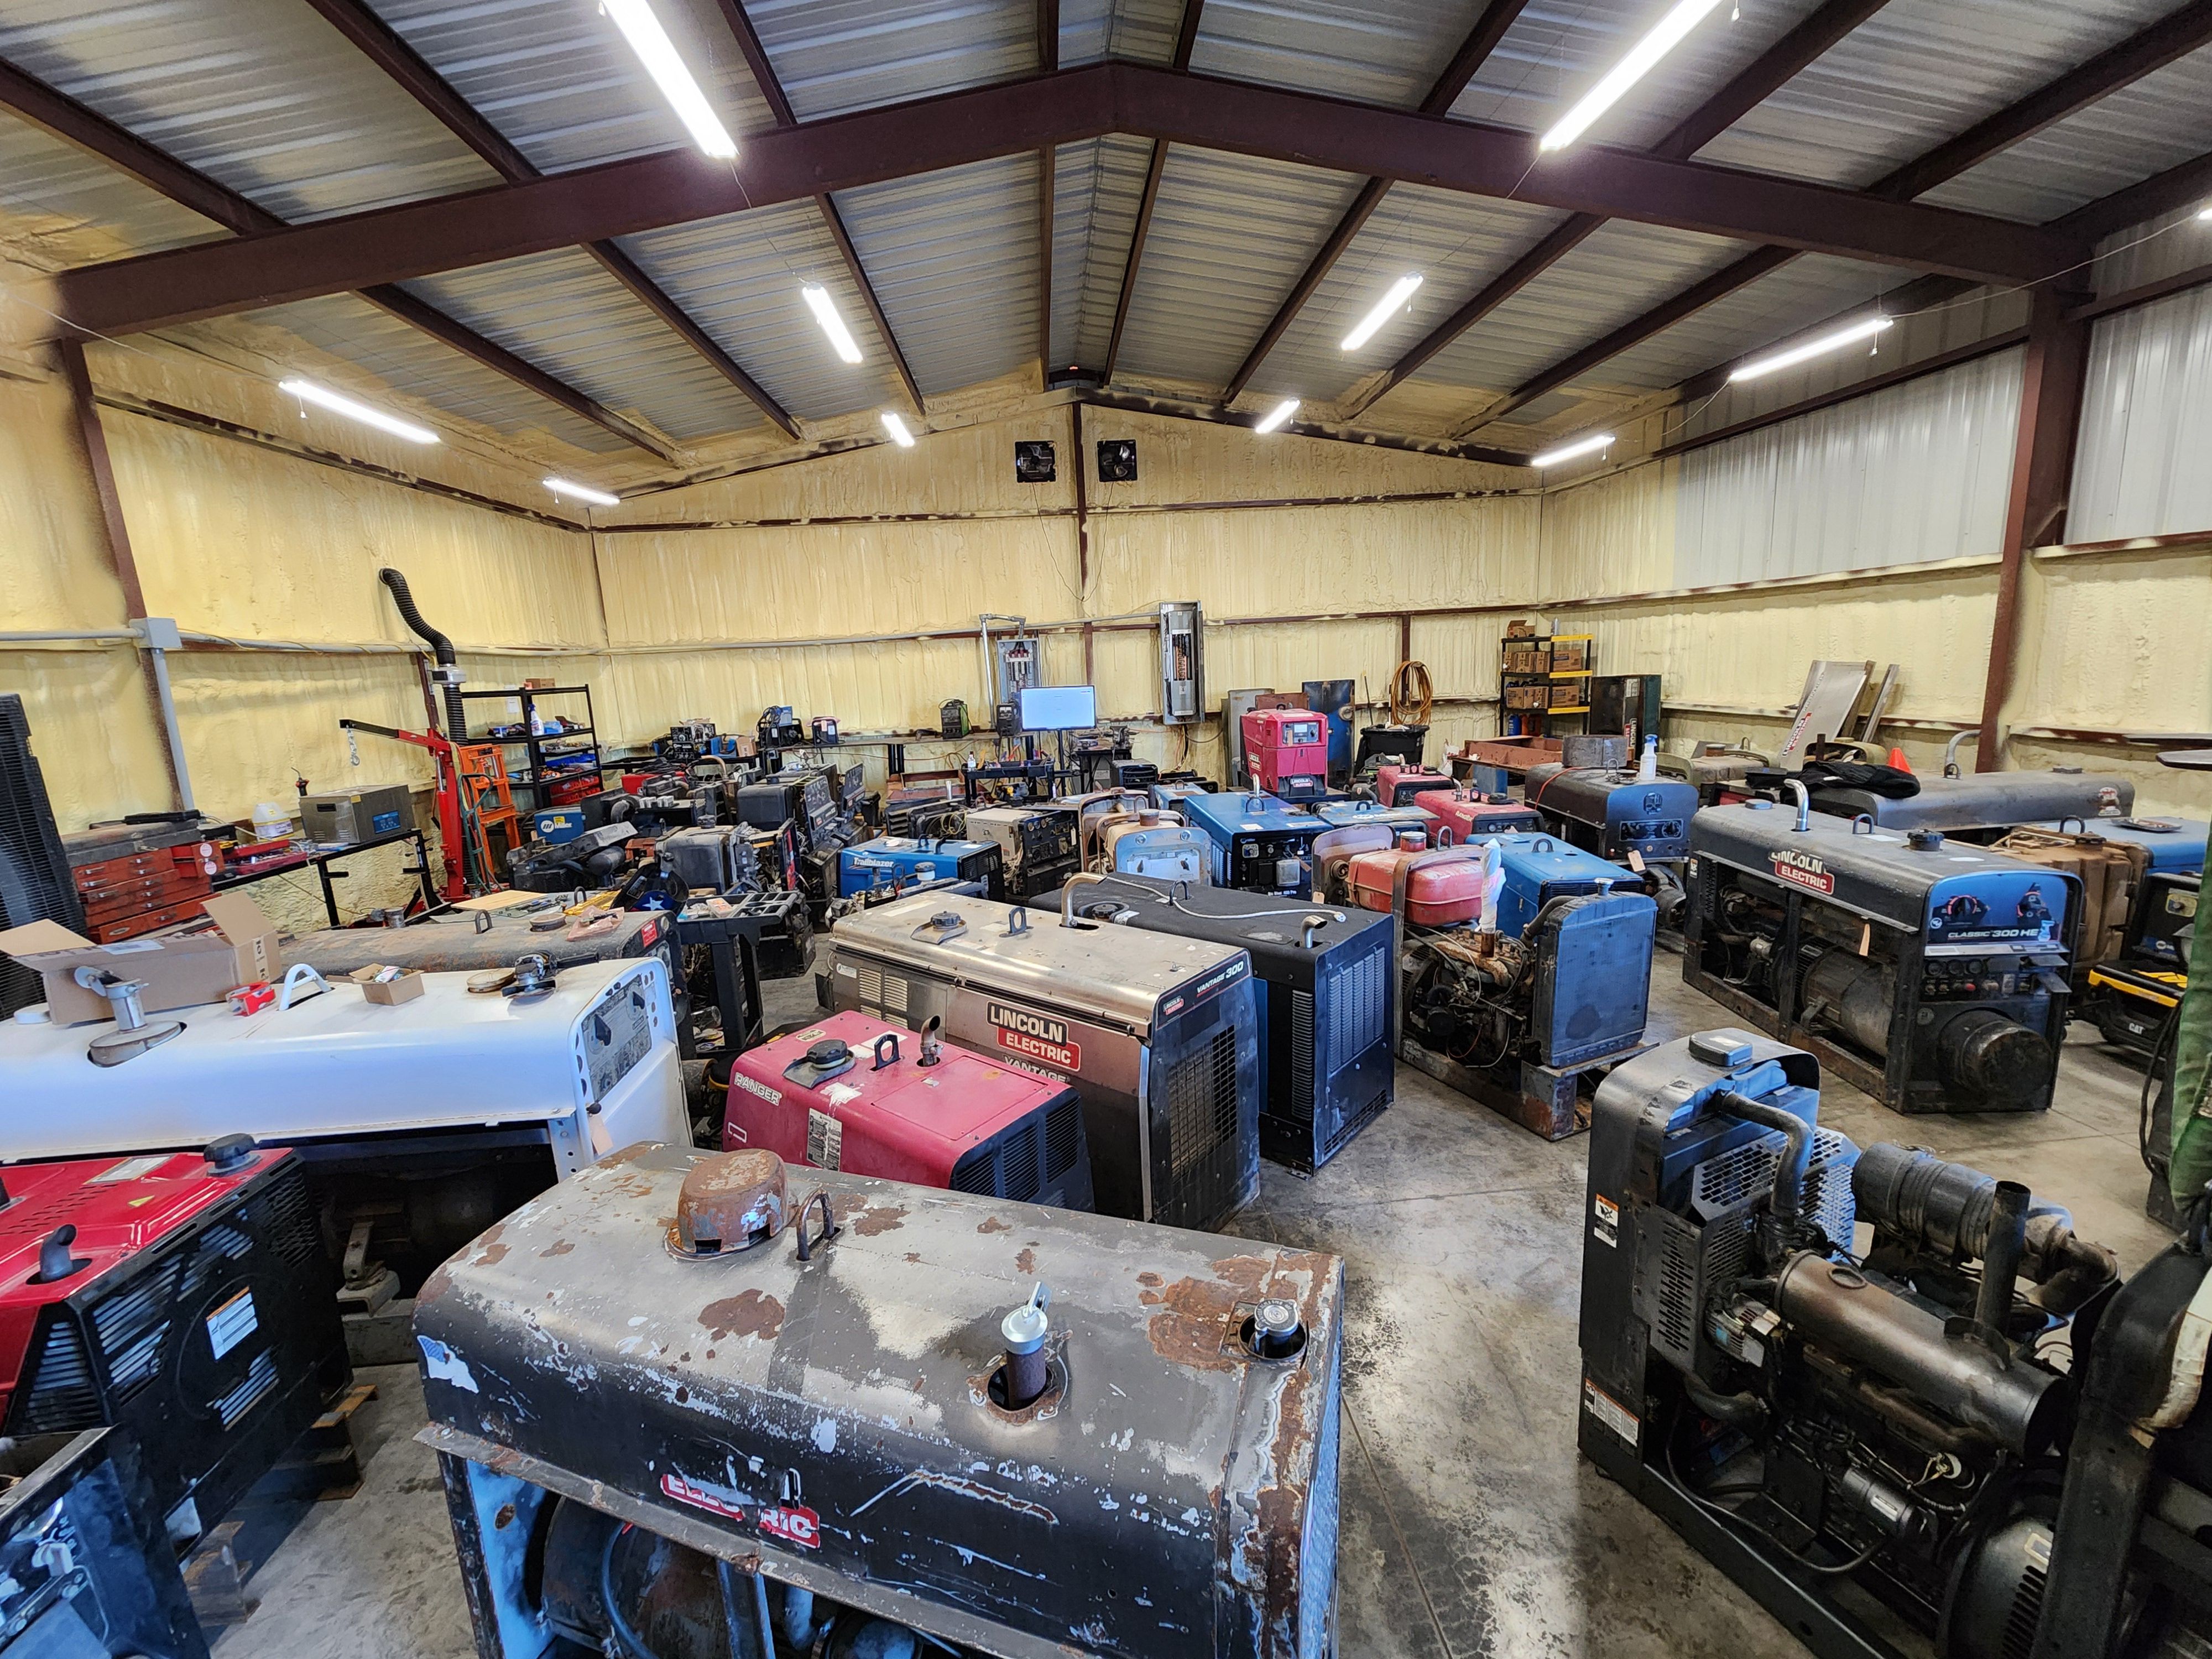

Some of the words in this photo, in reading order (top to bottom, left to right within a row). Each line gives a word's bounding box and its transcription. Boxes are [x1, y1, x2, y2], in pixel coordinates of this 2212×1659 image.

[1782, 719, 1804, 755] LINCOLN
[854, 857, 894, 868] Trailblazer
[1771, 851, 1823, 874] LINCOLN
[1781, 865, 1827, 889] ELECTRIC
[1991, 929, 2019, 937] 300
[1197, 973, 1225, 993] VANTAGE
[1225, 961, 1244, 979] 300
[990, 1005, 1063, 1043] LINCOLN
[2129, 1022, 2144, 1035] CAT
[1006, 1032, 1071, 1064] ELECTRIC
[1004, 1055, 1067, 1083] VANTAGE
[735, 1072, 782, 1106] RANGER
